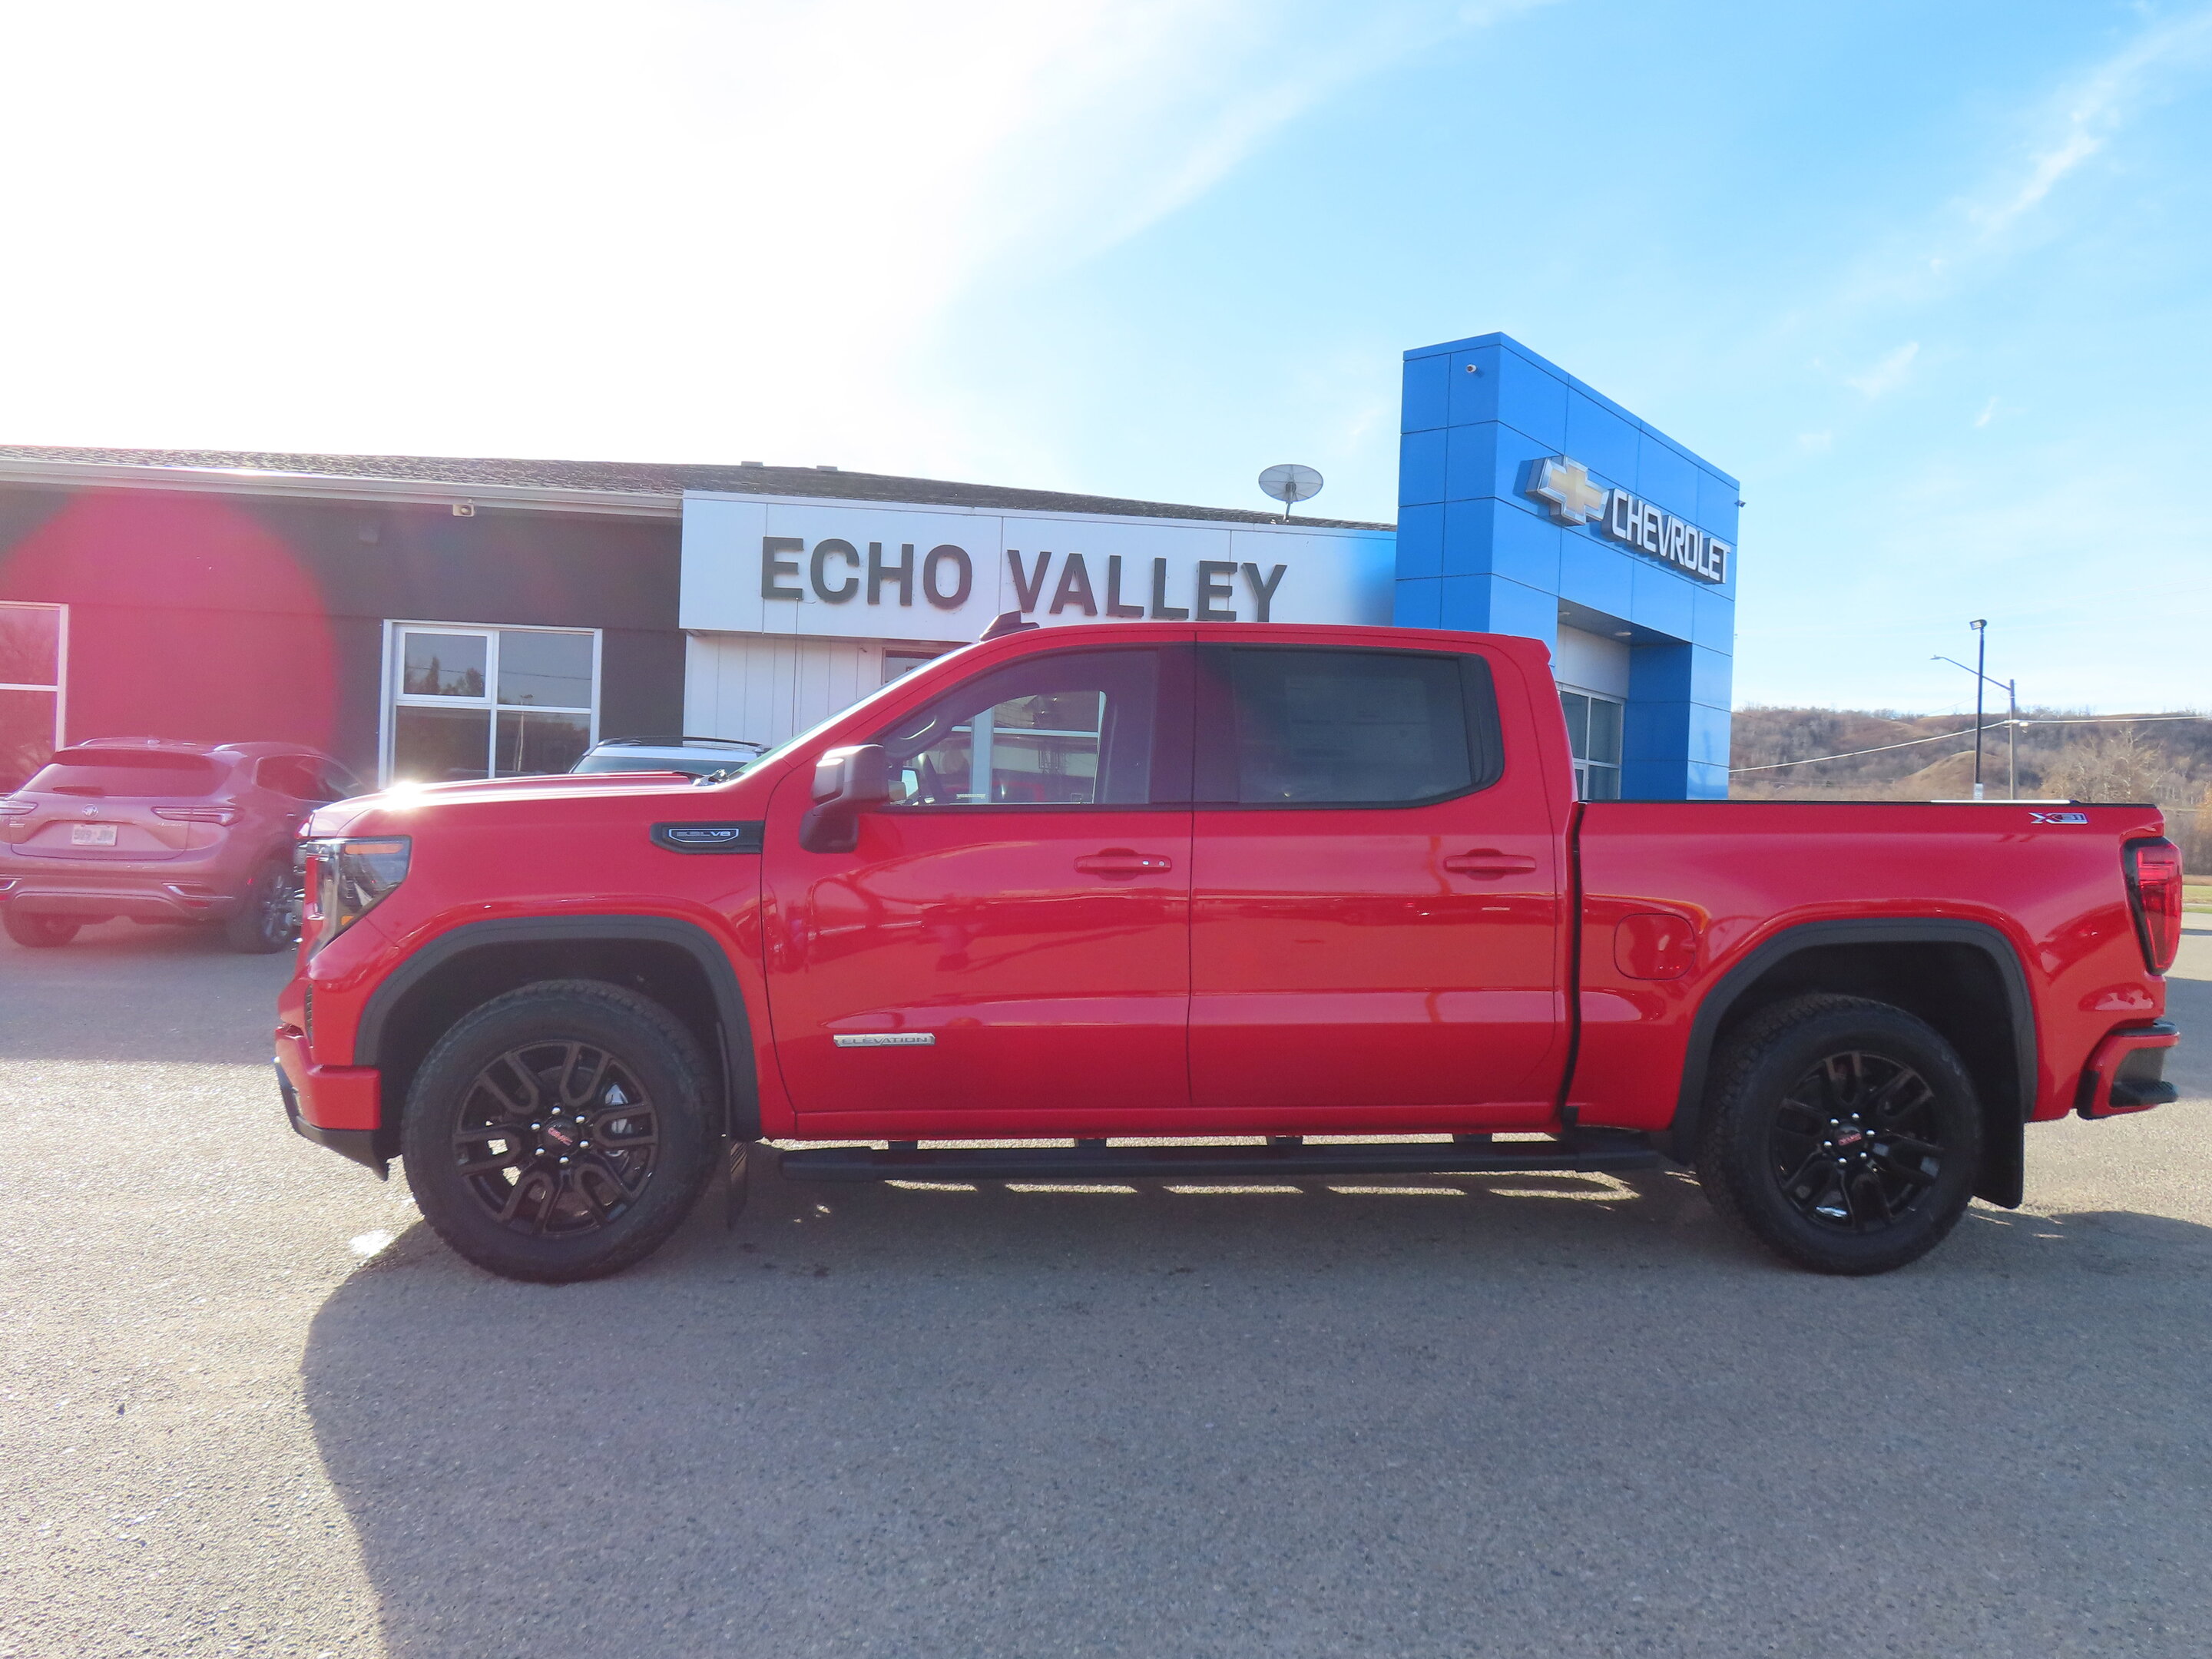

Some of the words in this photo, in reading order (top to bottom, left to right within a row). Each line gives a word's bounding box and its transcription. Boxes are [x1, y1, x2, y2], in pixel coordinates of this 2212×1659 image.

[761, 536, 972, 610] ECHO
[1007, 549, 1288, 622] VALLEY
[1612, 488, 1731, 584] CHEVROLET
